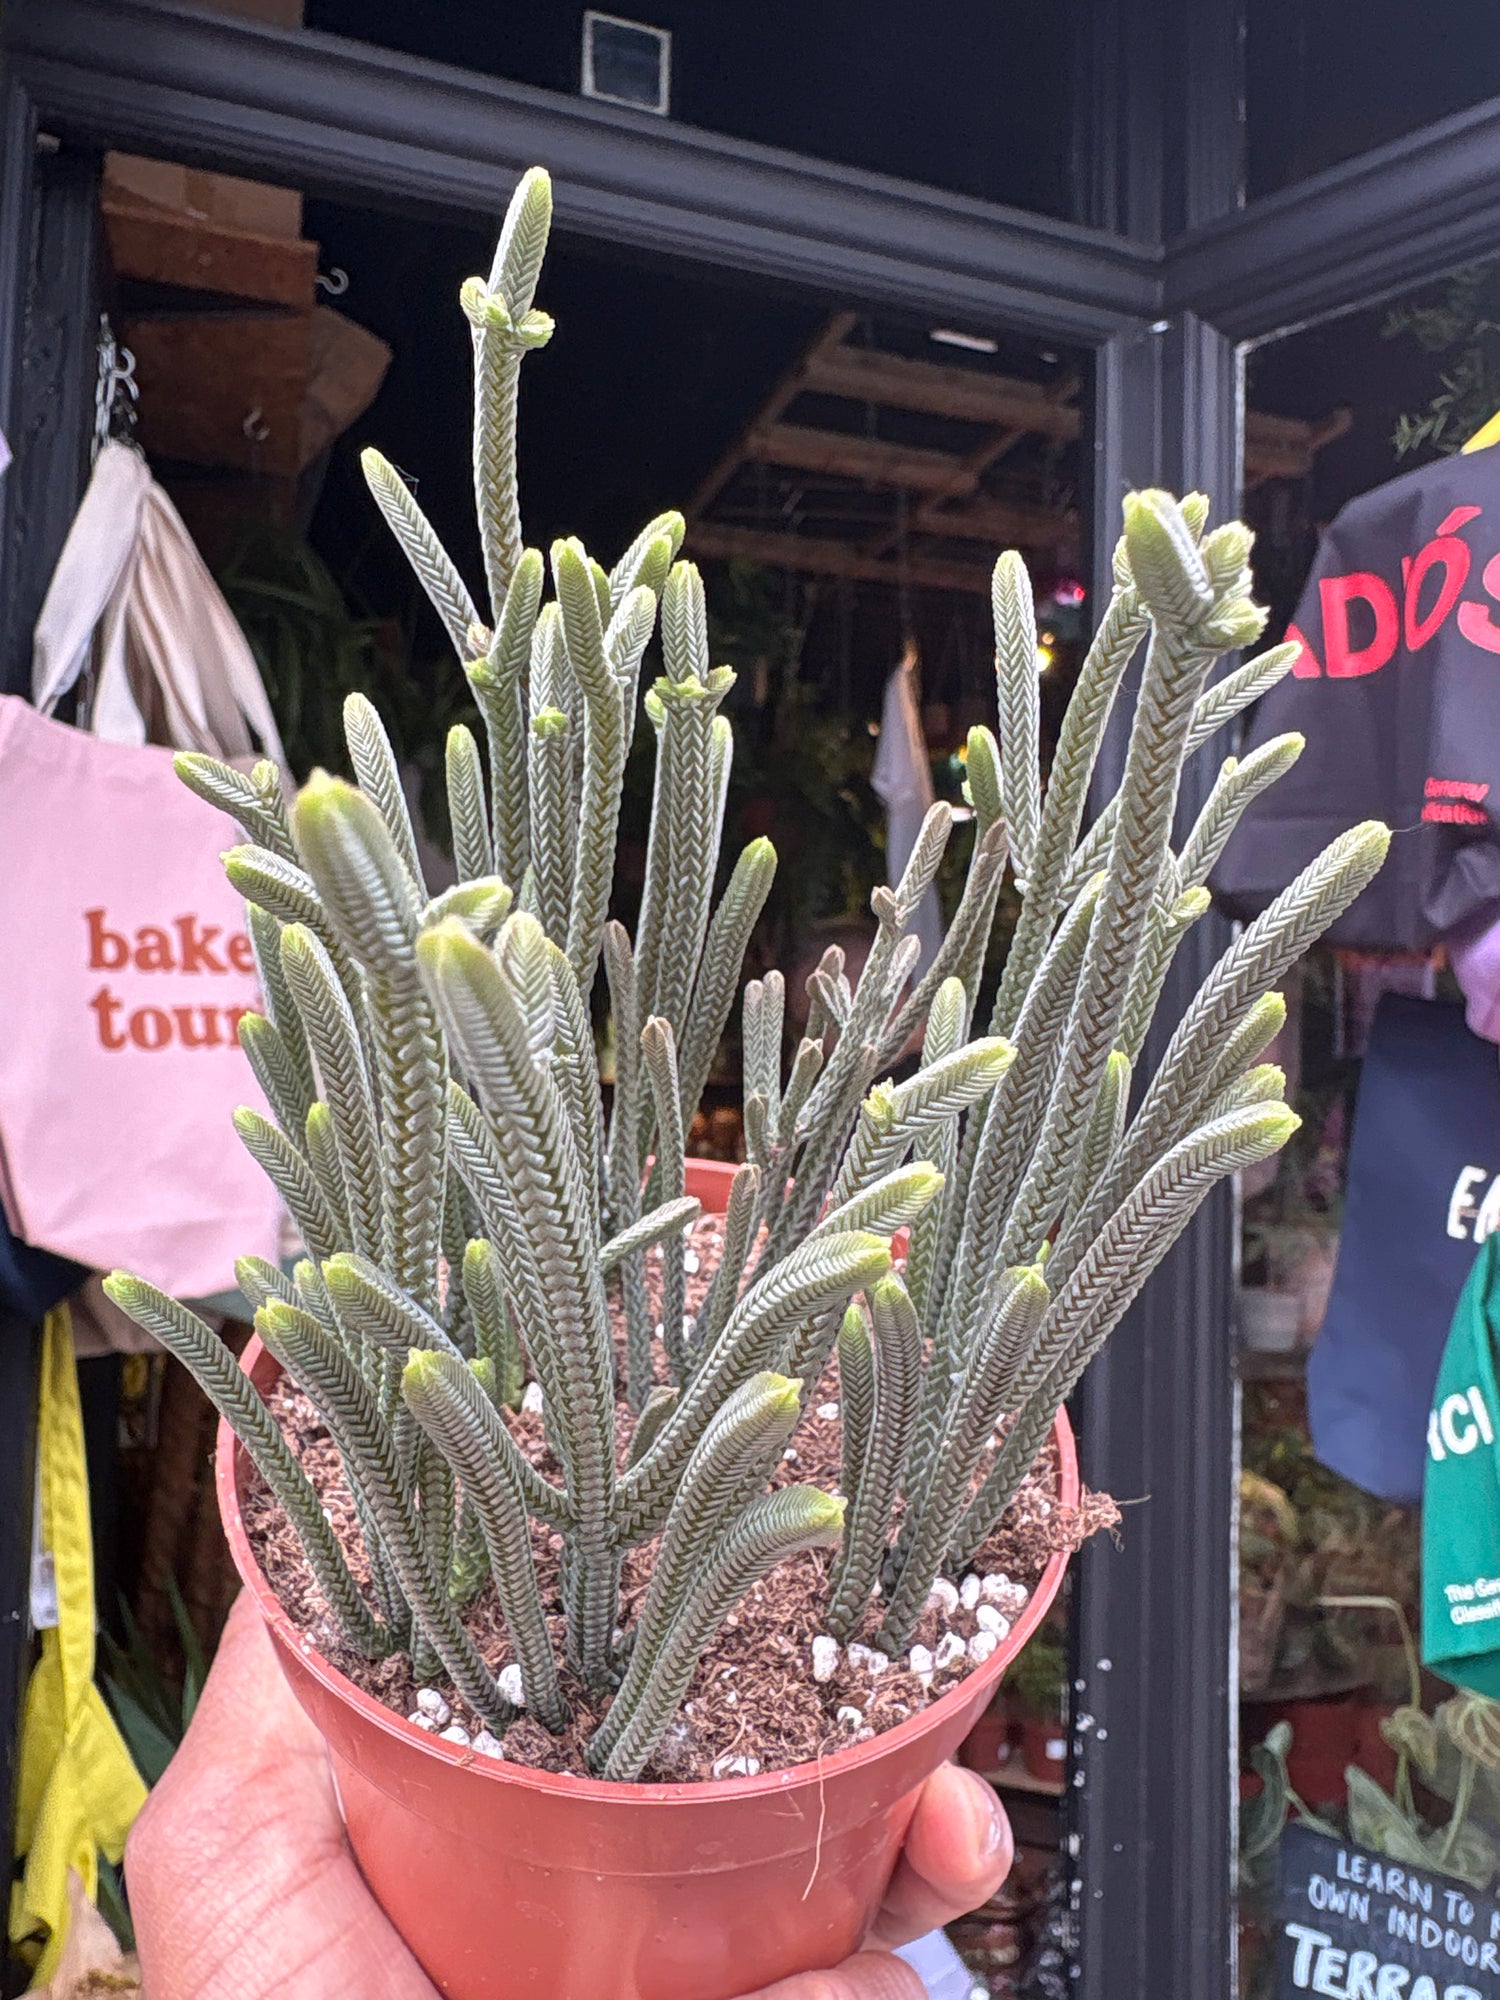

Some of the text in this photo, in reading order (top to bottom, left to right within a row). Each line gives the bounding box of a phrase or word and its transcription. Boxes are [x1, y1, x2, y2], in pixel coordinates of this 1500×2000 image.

[1308, 1873, 1370, 1925] OWN
[1388, 1904, 1500, 1975] INDOOR
[1336, 1849, 1433, 1913] LEARN
[1443, 1889, 1475, 1926] TO
